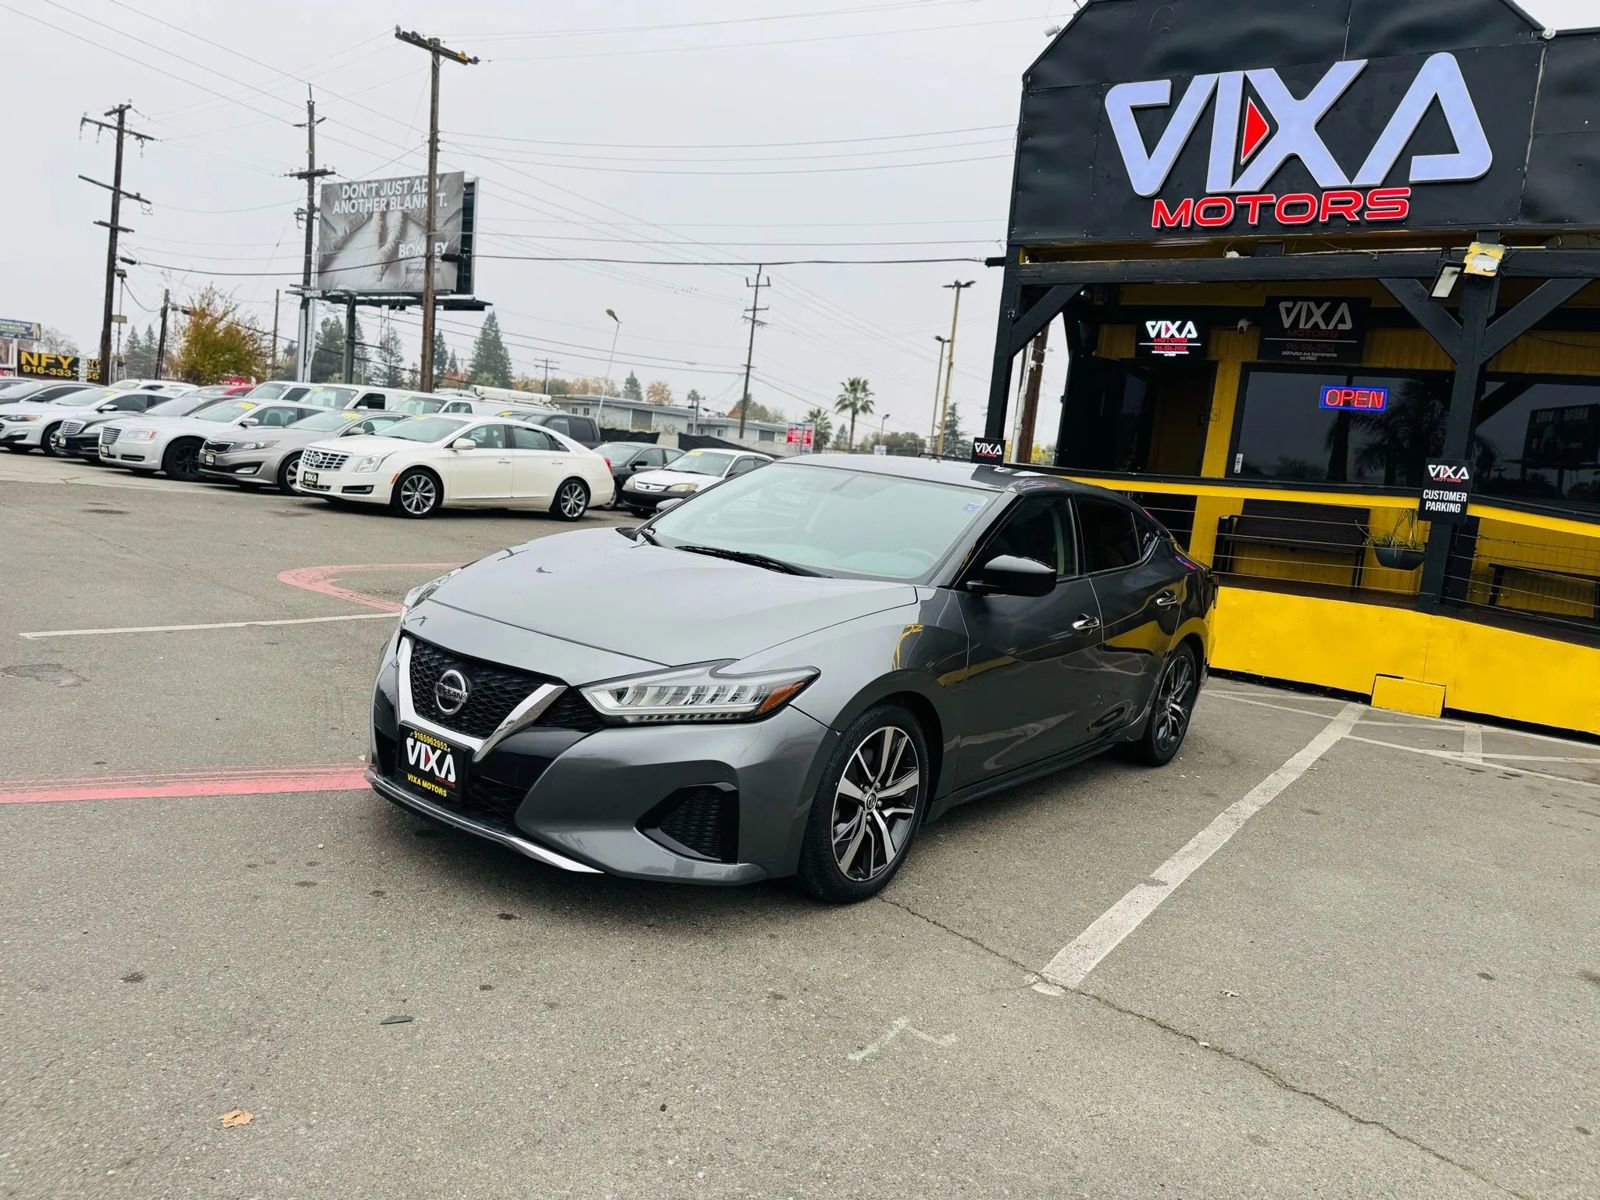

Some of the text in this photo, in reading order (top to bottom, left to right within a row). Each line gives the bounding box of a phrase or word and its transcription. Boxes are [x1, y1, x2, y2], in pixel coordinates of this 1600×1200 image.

[1105, 51, 1493, 196] VIXA
[342, 183, 378, 199] DON'T
[380, 180, 410, 196] JUST
[332, 193, 447, 214] ANOTHER BLANKT.
[1152, 187, 1412, 229] MOTORS
[399, 241, 449, 258] BONEY
[1279, 301, 1353, 330] VIXA
[1145, 320, 1198, 339] VIXA
[21, 351, 75, 369] NFY
[1325, 389, 1384, 408] OPEN
[974, 442, 1002, 455] VIXA
[1428, 464, 1470, 480] VIXA
[1423, 489, 1467, 502] CUSTOMER
[1425, 501, 1461, 513] PARKING
[406, 737, 456, 782] VIXA
[407, 773, 447, 797] VIXA MOTORS
